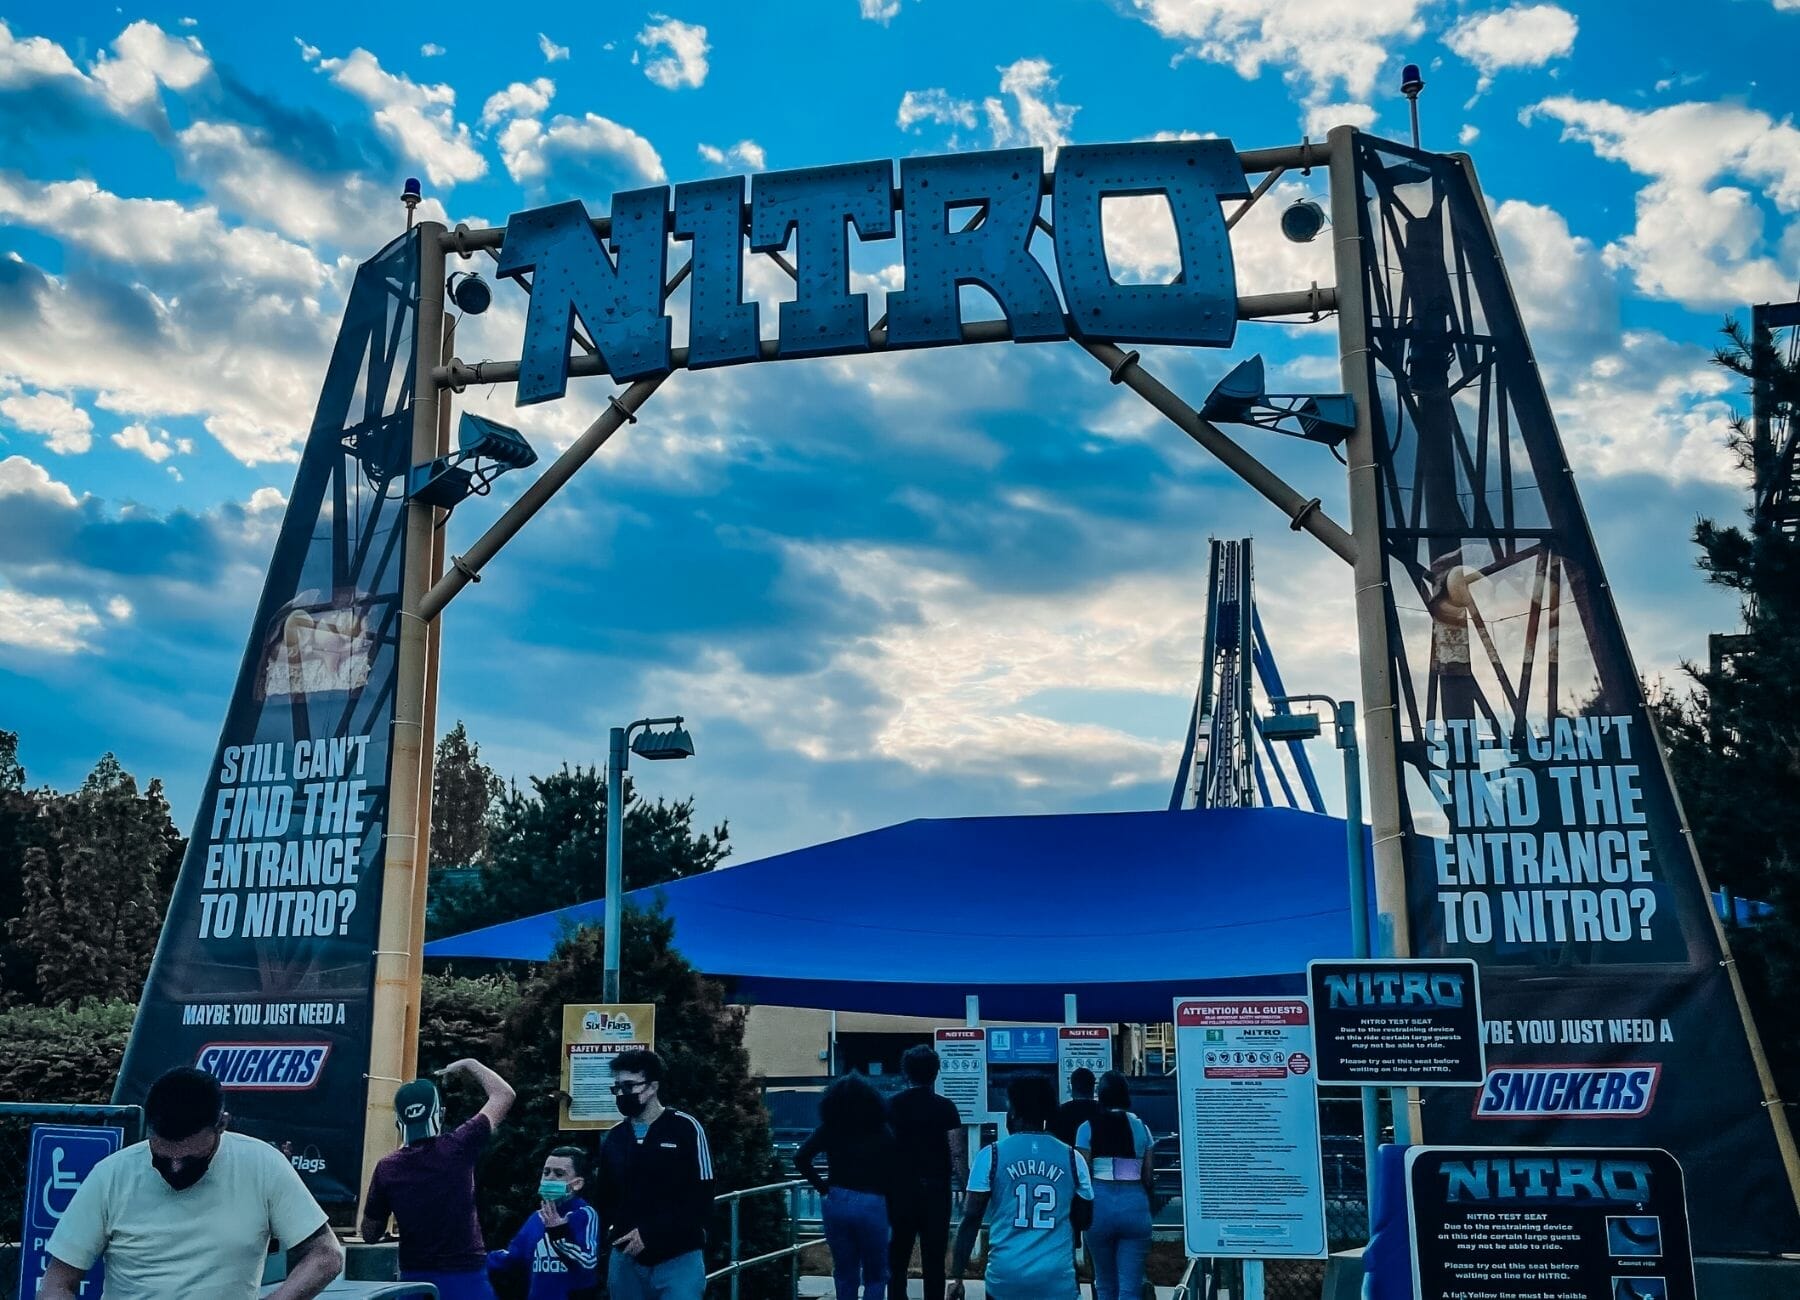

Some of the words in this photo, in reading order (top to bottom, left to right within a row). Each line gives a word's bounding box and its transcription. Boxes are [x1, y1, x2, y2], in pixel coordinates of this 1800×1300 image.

[495, 139, 1253, 407] NITRO
[221, 742, 286, 783] STILL
[293, 735, 370, 779] CAN'T
[1527, 716, 1632, 761] CAN'T
[211, 785, 293, 839] FIND
[303, 780, 367, 835] THE
[1429, 767, 1540, 828] FIND
[1549, 766, 1647, 825] THE
[203, 838, 361, 888] ENTRANCE
[1433, 830, 1653, 884] ENTRANCE
[199, 893, 238, 938] TO
[241, 889, 357, 937] NITRO?
[1438, 892, 1492, 943] TO
[1502, 889, 1656, 942] NITRO?
[1324, 972, 1464, 1009] NITRO
[183, 1004, 230, 1024] MAYBE
[234, 1004, 261, 1024] YOU
[263, 1004, 297, 1024] JUST
[299, 1003, 333, 1024] NEED
[335, 1003, 345, 1024] A
[608, 1022, 631, 1031] Flags
[1481, 1021, 1513, 1044] YBE
[1517, 1020, 1555, 1043] YOU
[1561, 1019, 1604, 1043] JUST
[1608, 1019, 1655, 1043] NEED
[1660, 1019, 1673, 1042] A
[202, 1049, 323, 1082] SNICKERS
[1483, 1071, 1650, 1111] SNICKERS
[292, 1155, 325, 1173] Flags
[1006, 1160, 1064, 1182] MORANT
[1438, 1158, 1652, 1202] NITRO
[1014, 1184, 1056, 1229] 12
[1524, 1233, 1548, 1241] large
[532, 1257, 568, 1272] adidas
